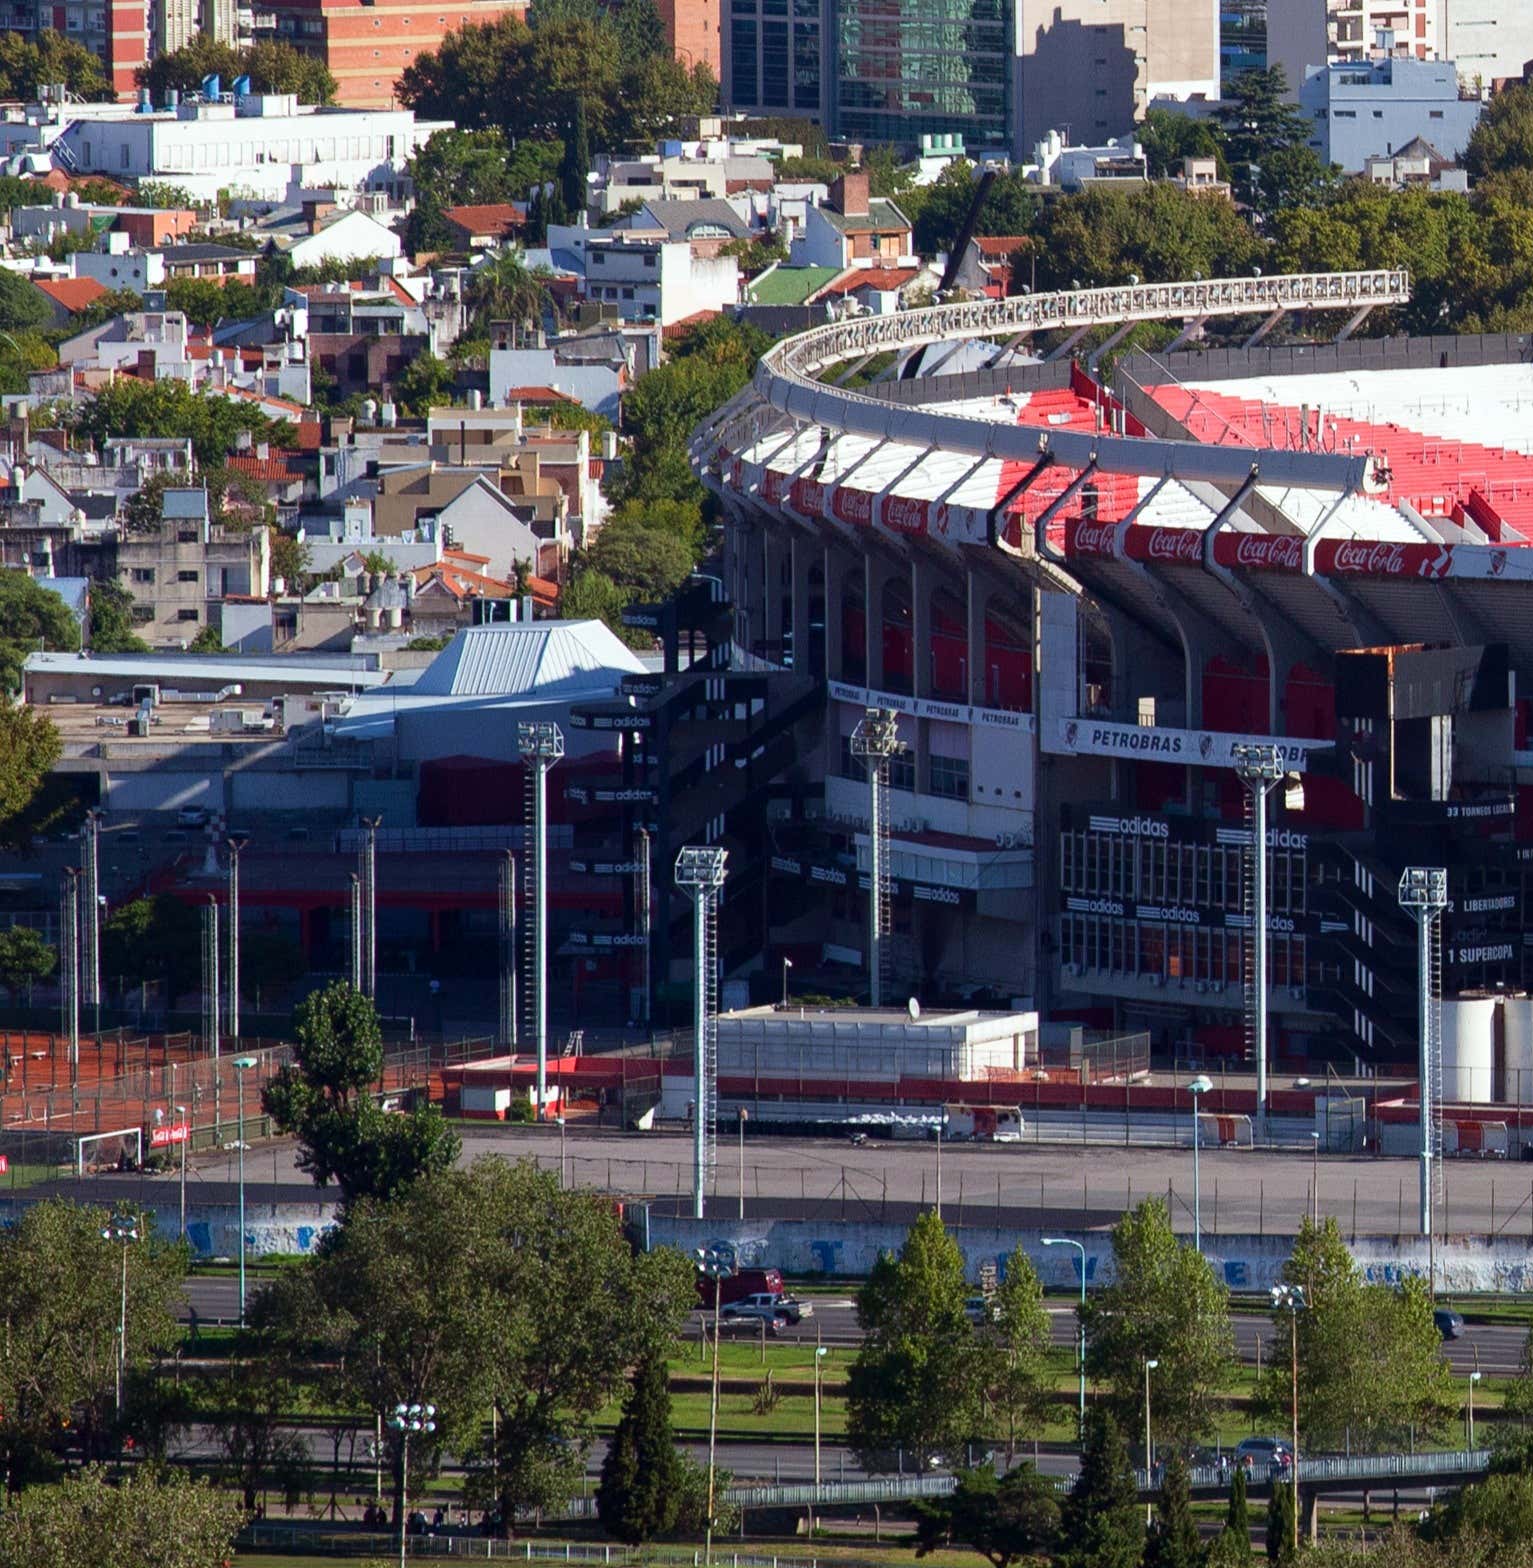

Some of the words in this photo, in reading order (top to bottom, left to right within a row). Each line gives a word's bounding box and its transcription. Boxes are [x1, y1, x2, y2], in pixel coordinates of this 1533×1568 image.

[1335, 540, 1403, 573] Coca-Cola
[1092, 729, 1182, 753] PETROBRAS
[1120, 816, 1169, 838] adidas
[931, 887, 960, 905] adidas
[1464, 896, 1515, 912] LIBERTADORES
[1089, 899, 1124, 914] adidas
[1160, 905, 1200, 922] adidas
[1460, 945, 1513, 963] SUPERCOPA
